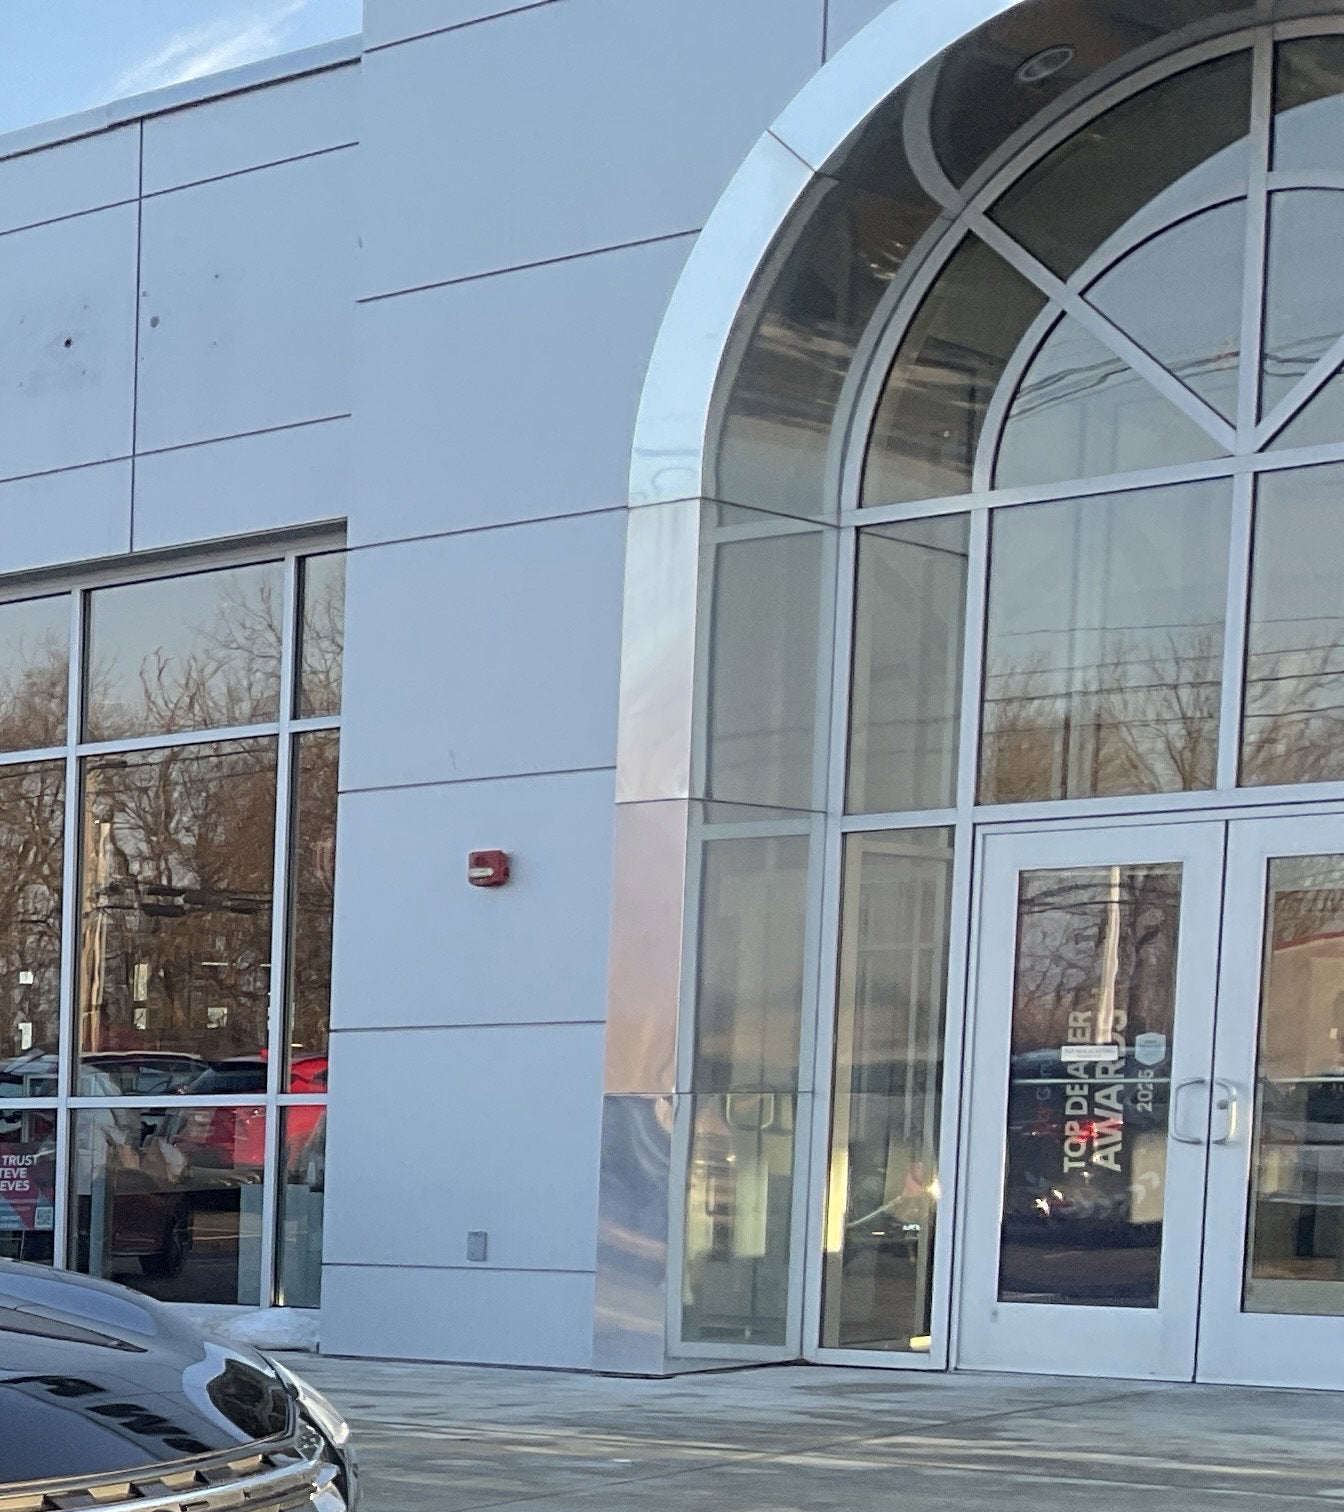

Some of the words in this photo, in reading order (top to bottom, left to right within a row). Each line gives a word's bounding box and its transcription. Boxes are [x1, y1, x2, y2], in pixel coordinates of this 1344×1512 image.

[1065, 1010, 1092, 1115] DEAER
[1, 1155, 38, 1167] TRUST
[1063, 1120, 1087, 1173] TOP
